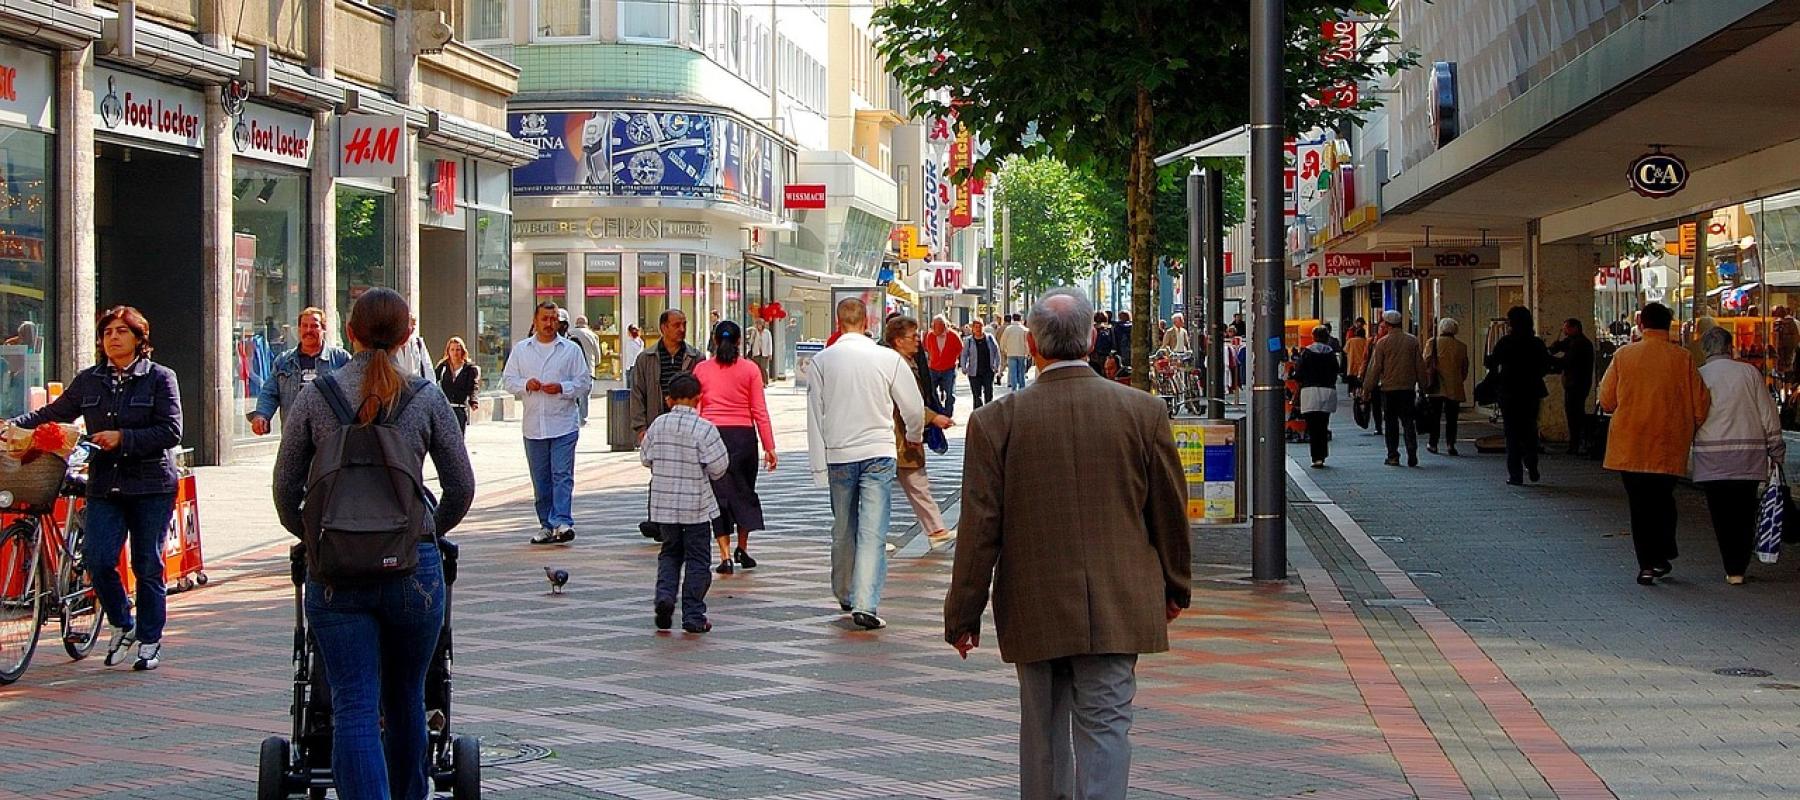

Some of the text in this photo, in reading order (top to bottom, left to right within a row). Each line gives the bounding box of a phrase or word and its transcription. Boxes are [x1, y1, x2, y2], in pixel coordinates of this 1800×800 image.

[124, 92, 199, 139] Foot Locker
[251, 119, 309, 159] Foot Locker
[345, 127, 400, 165] H&M
[1640, 164, 1680, 184] C&A
[785, 192, 825, 201] WISSMACH
[1434, 253, 1480, 267] RENO
[1391, 267, 1430, 279] RENO
